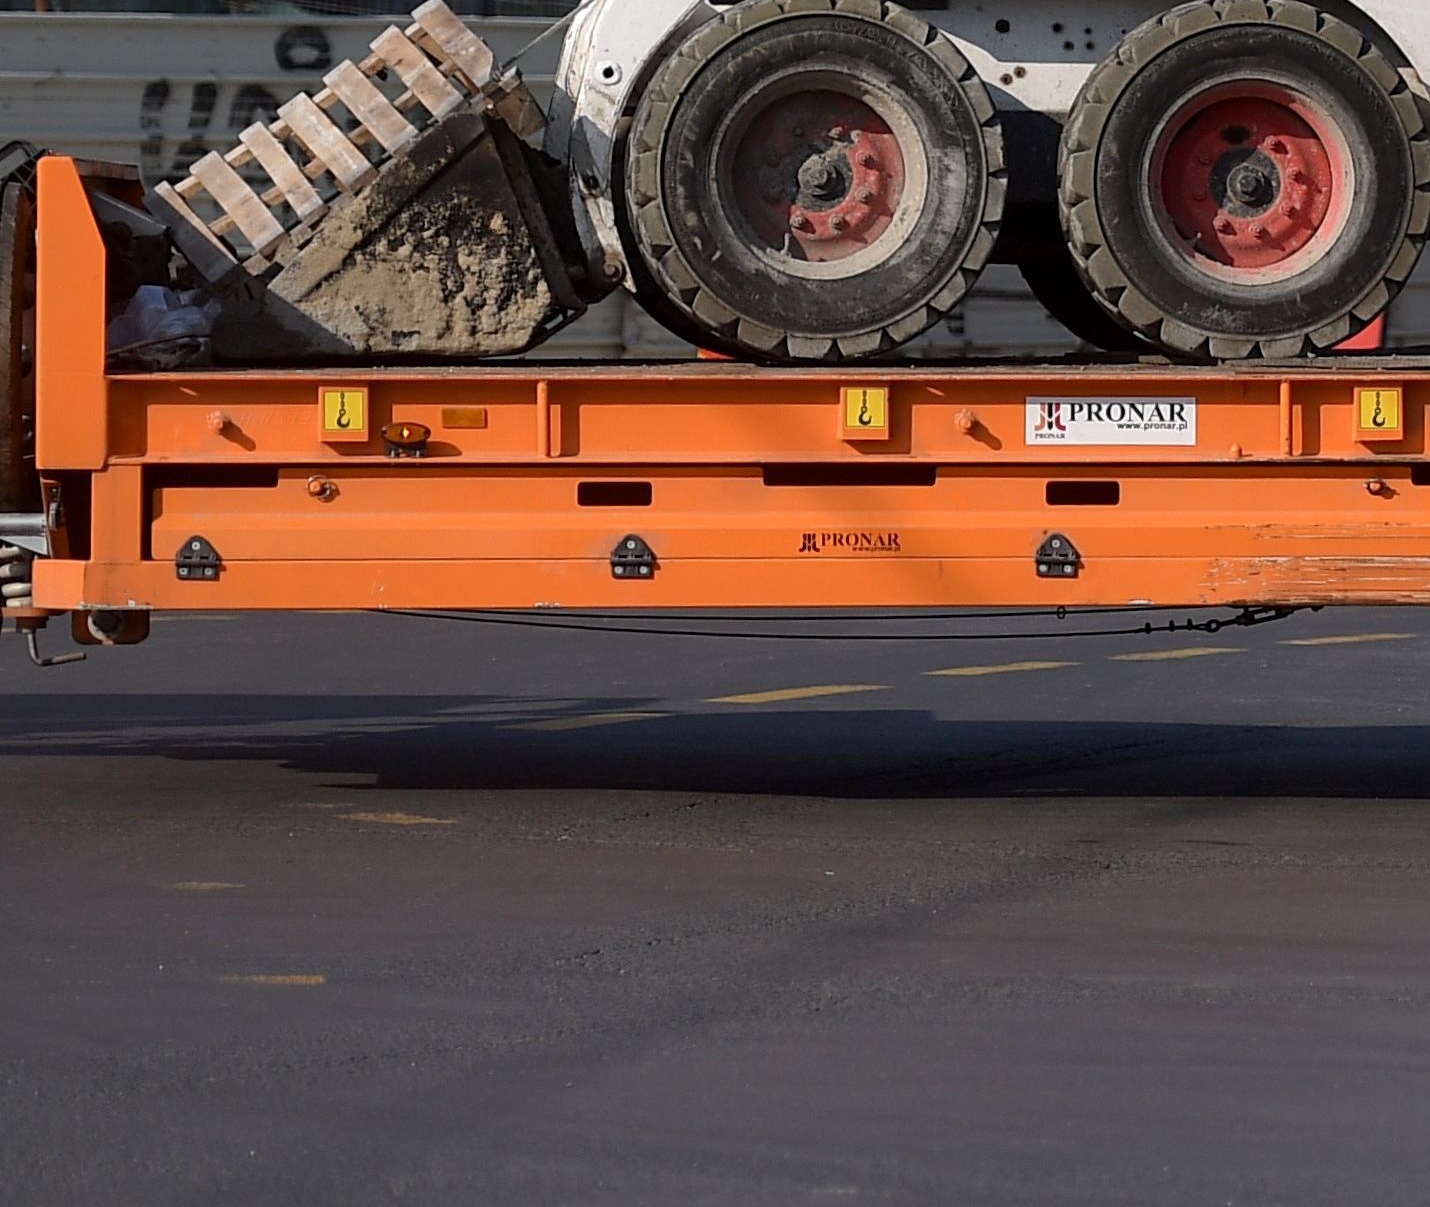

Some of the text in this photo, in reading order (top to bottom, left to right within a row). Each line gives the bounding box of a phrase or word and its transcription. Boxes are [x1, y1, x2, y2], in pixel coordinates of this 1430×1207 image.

[1068, 401, 1186, 422] PRONAR
[1116, 421, 1188, 431] www.pronar.pl
[1034, 432, 1066, 440] PRONAR
[821, 532, 900, 547] PRONAR
